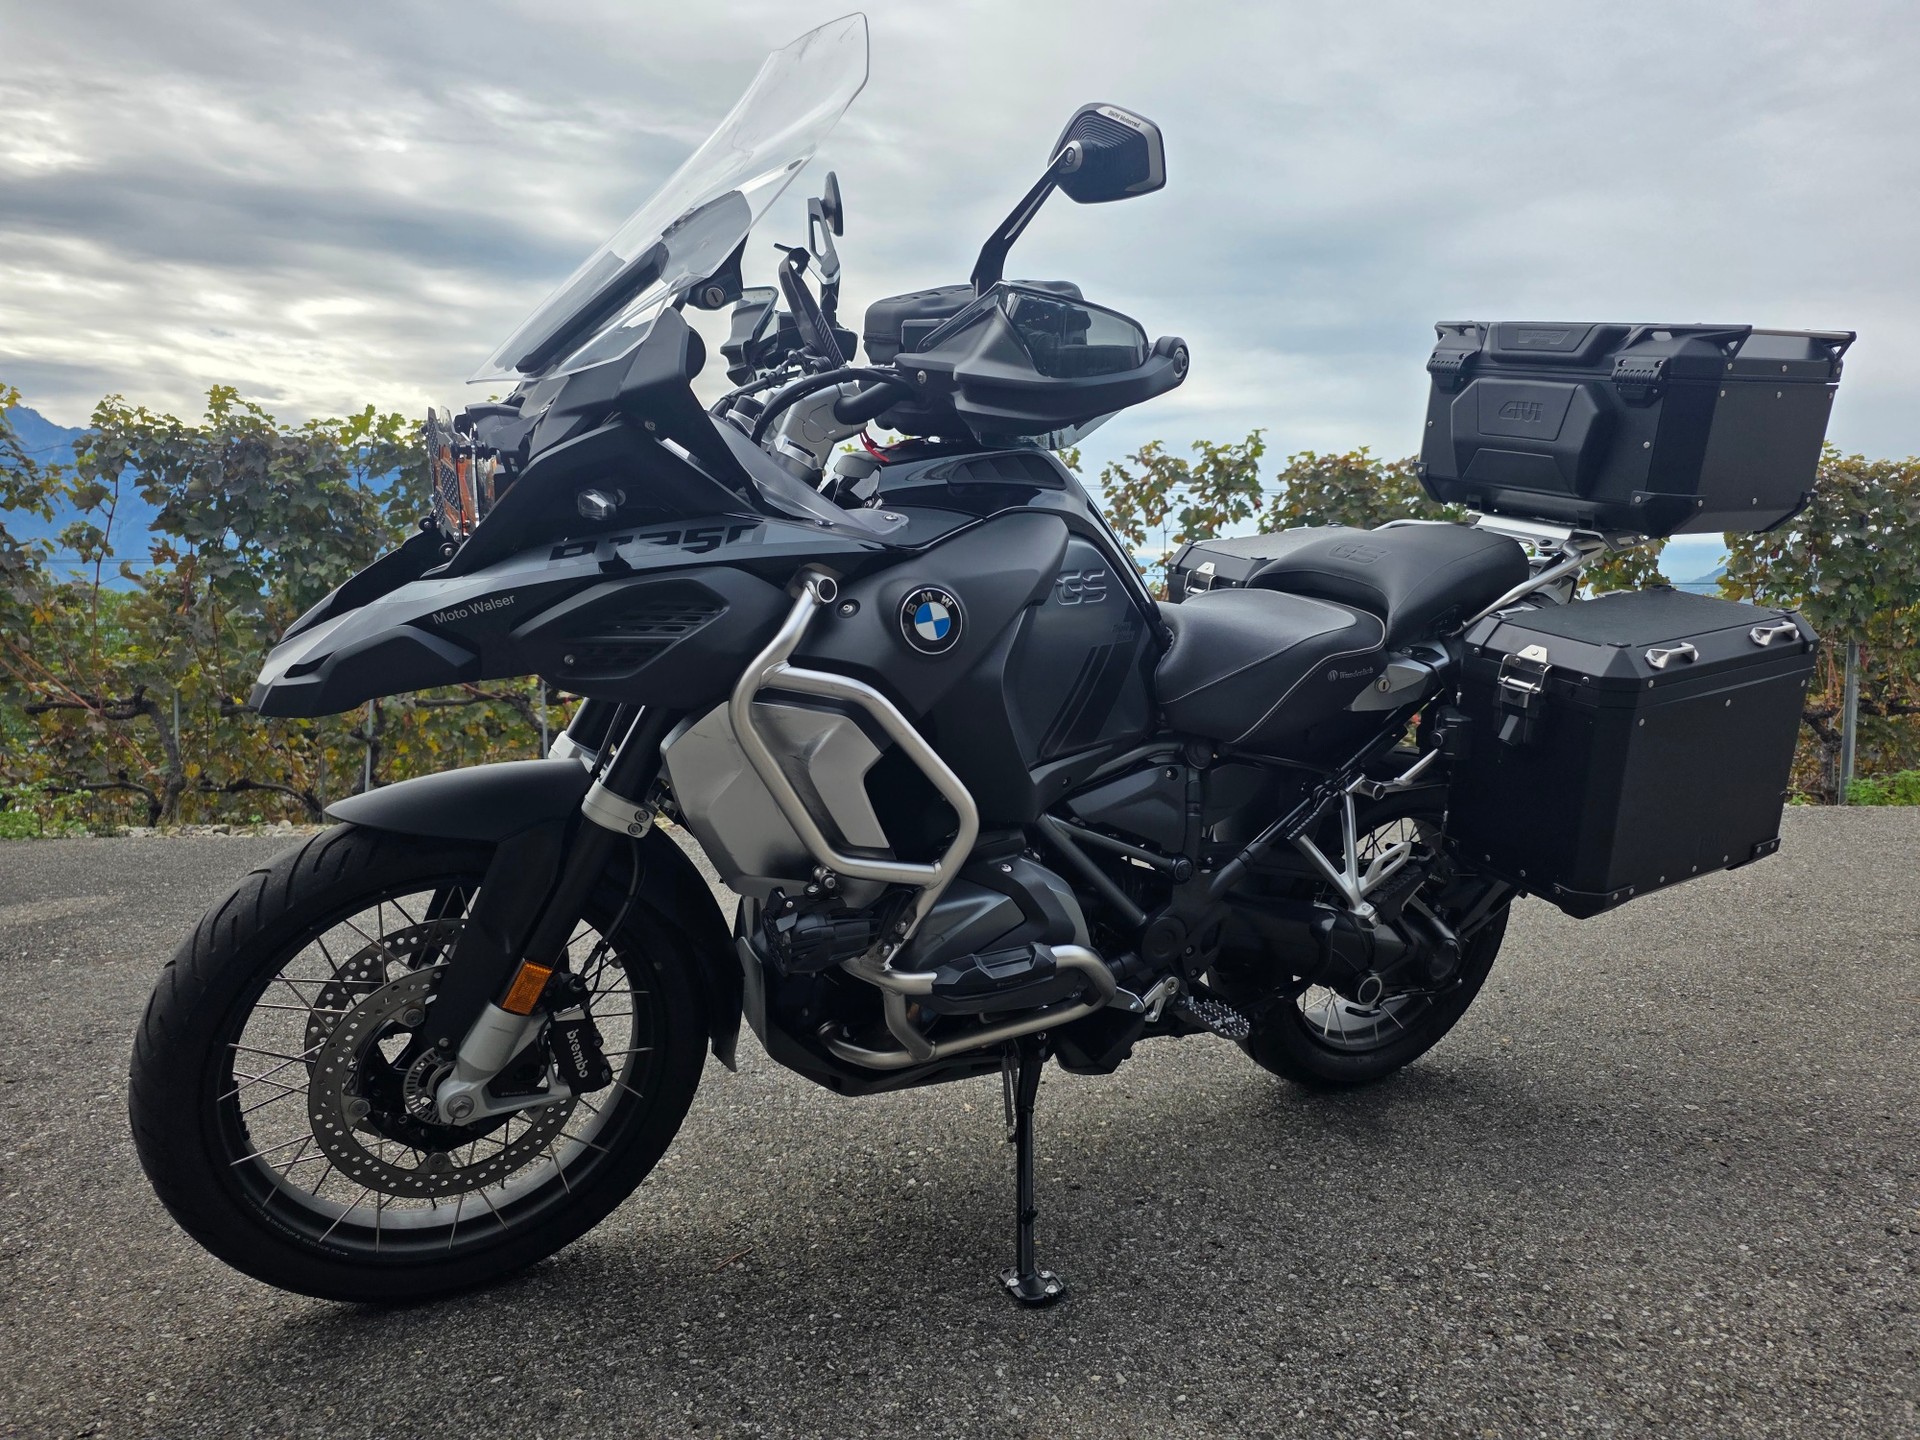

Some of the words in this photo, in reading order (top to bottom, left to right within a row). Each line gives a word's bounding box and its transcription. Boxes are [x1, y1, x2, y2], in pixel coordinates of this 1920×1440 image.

[1498, 400, 1543, 423] GIVI
[1055, 569, 1107, 606] GS
[432, 609, 468, 625] Moto
[468, 595, 515, 615] Walser
[906, 592, 953, 616] BMW
[566, 1028, 589, 1078] brembo
